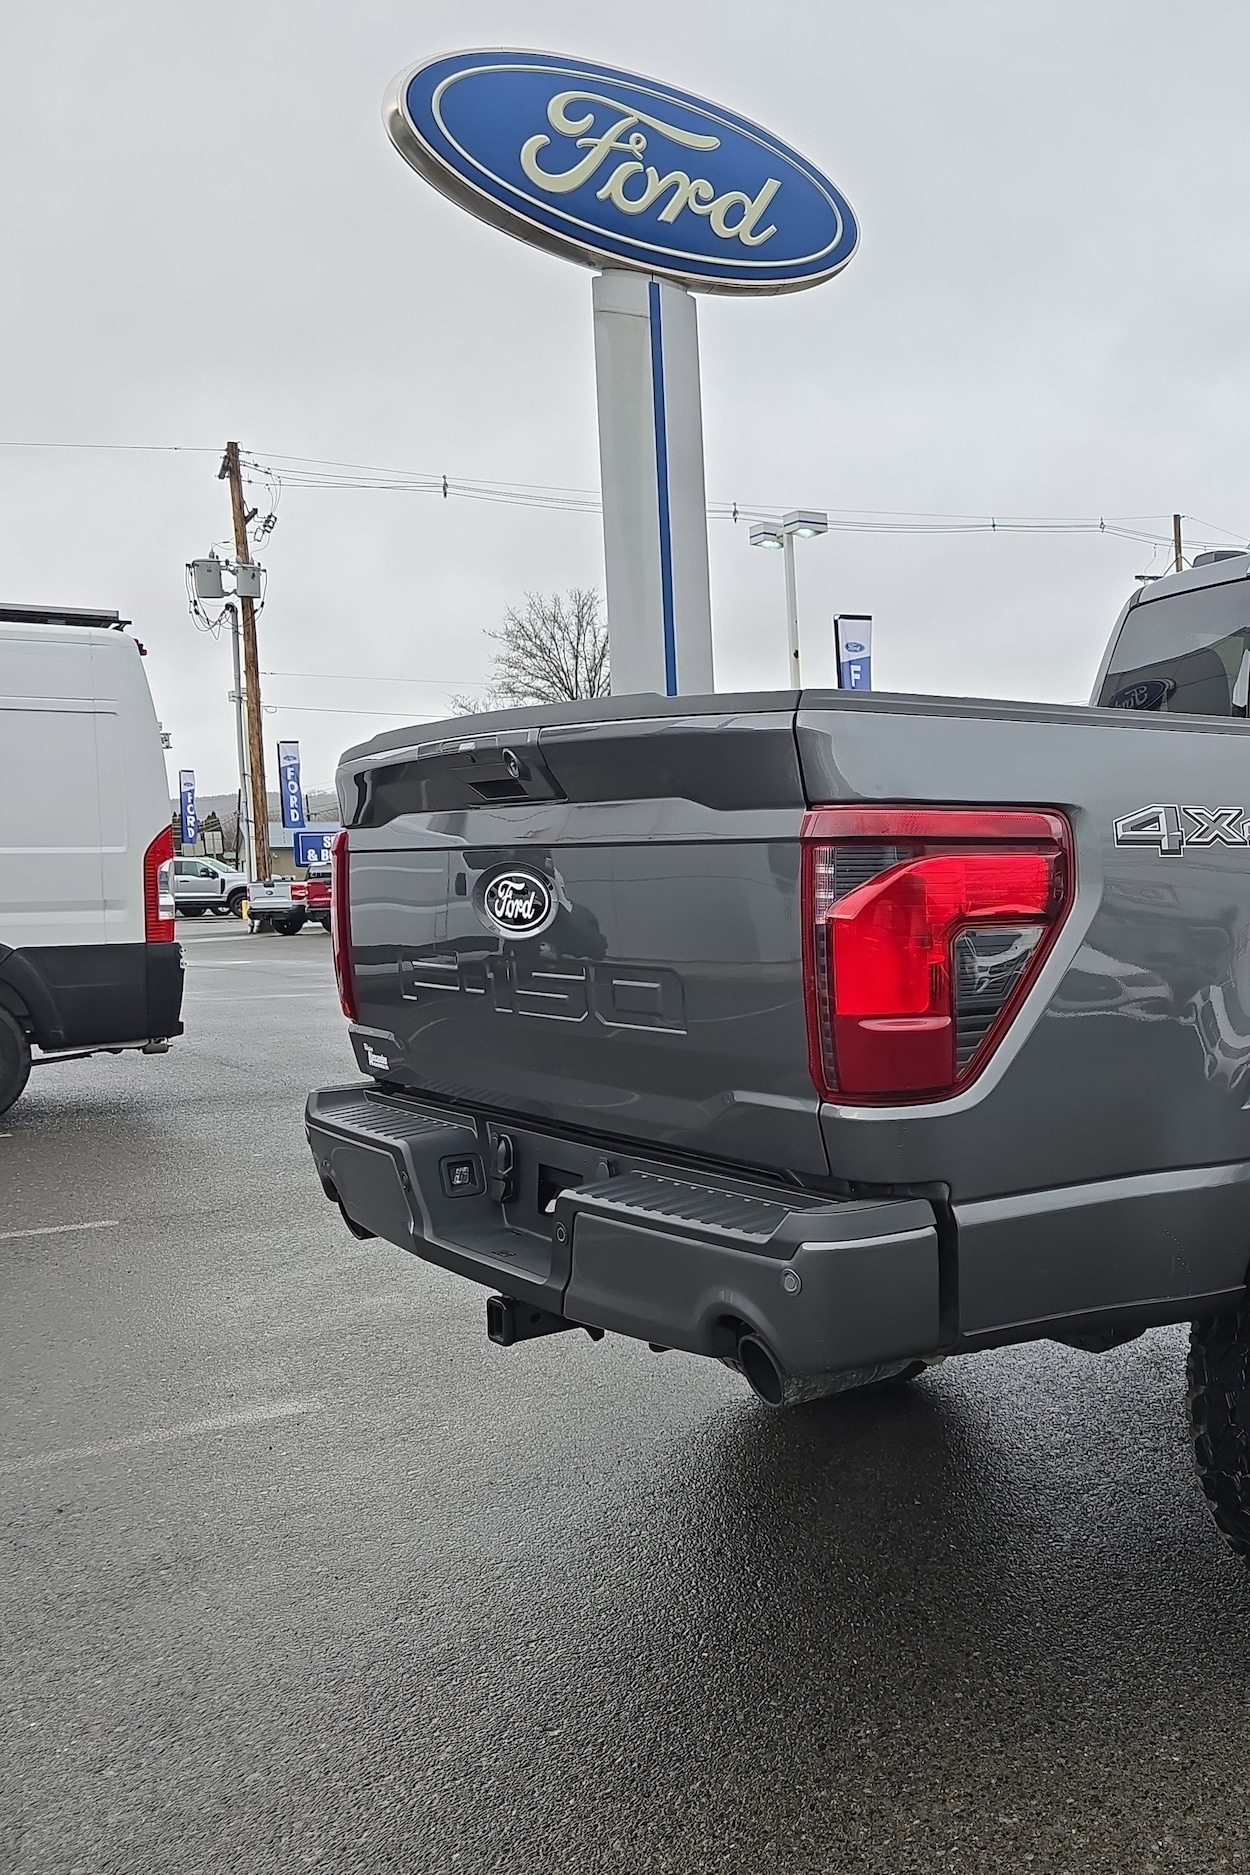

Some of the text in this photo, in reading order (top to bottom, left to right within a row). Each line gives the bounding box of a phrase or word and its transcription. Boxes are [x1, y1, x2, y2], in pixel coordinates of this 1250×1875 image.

[520, 90, 782, 247] Ford
[286, 767, 300, 822] FORD
[495, 880, 535, 919] Ford
